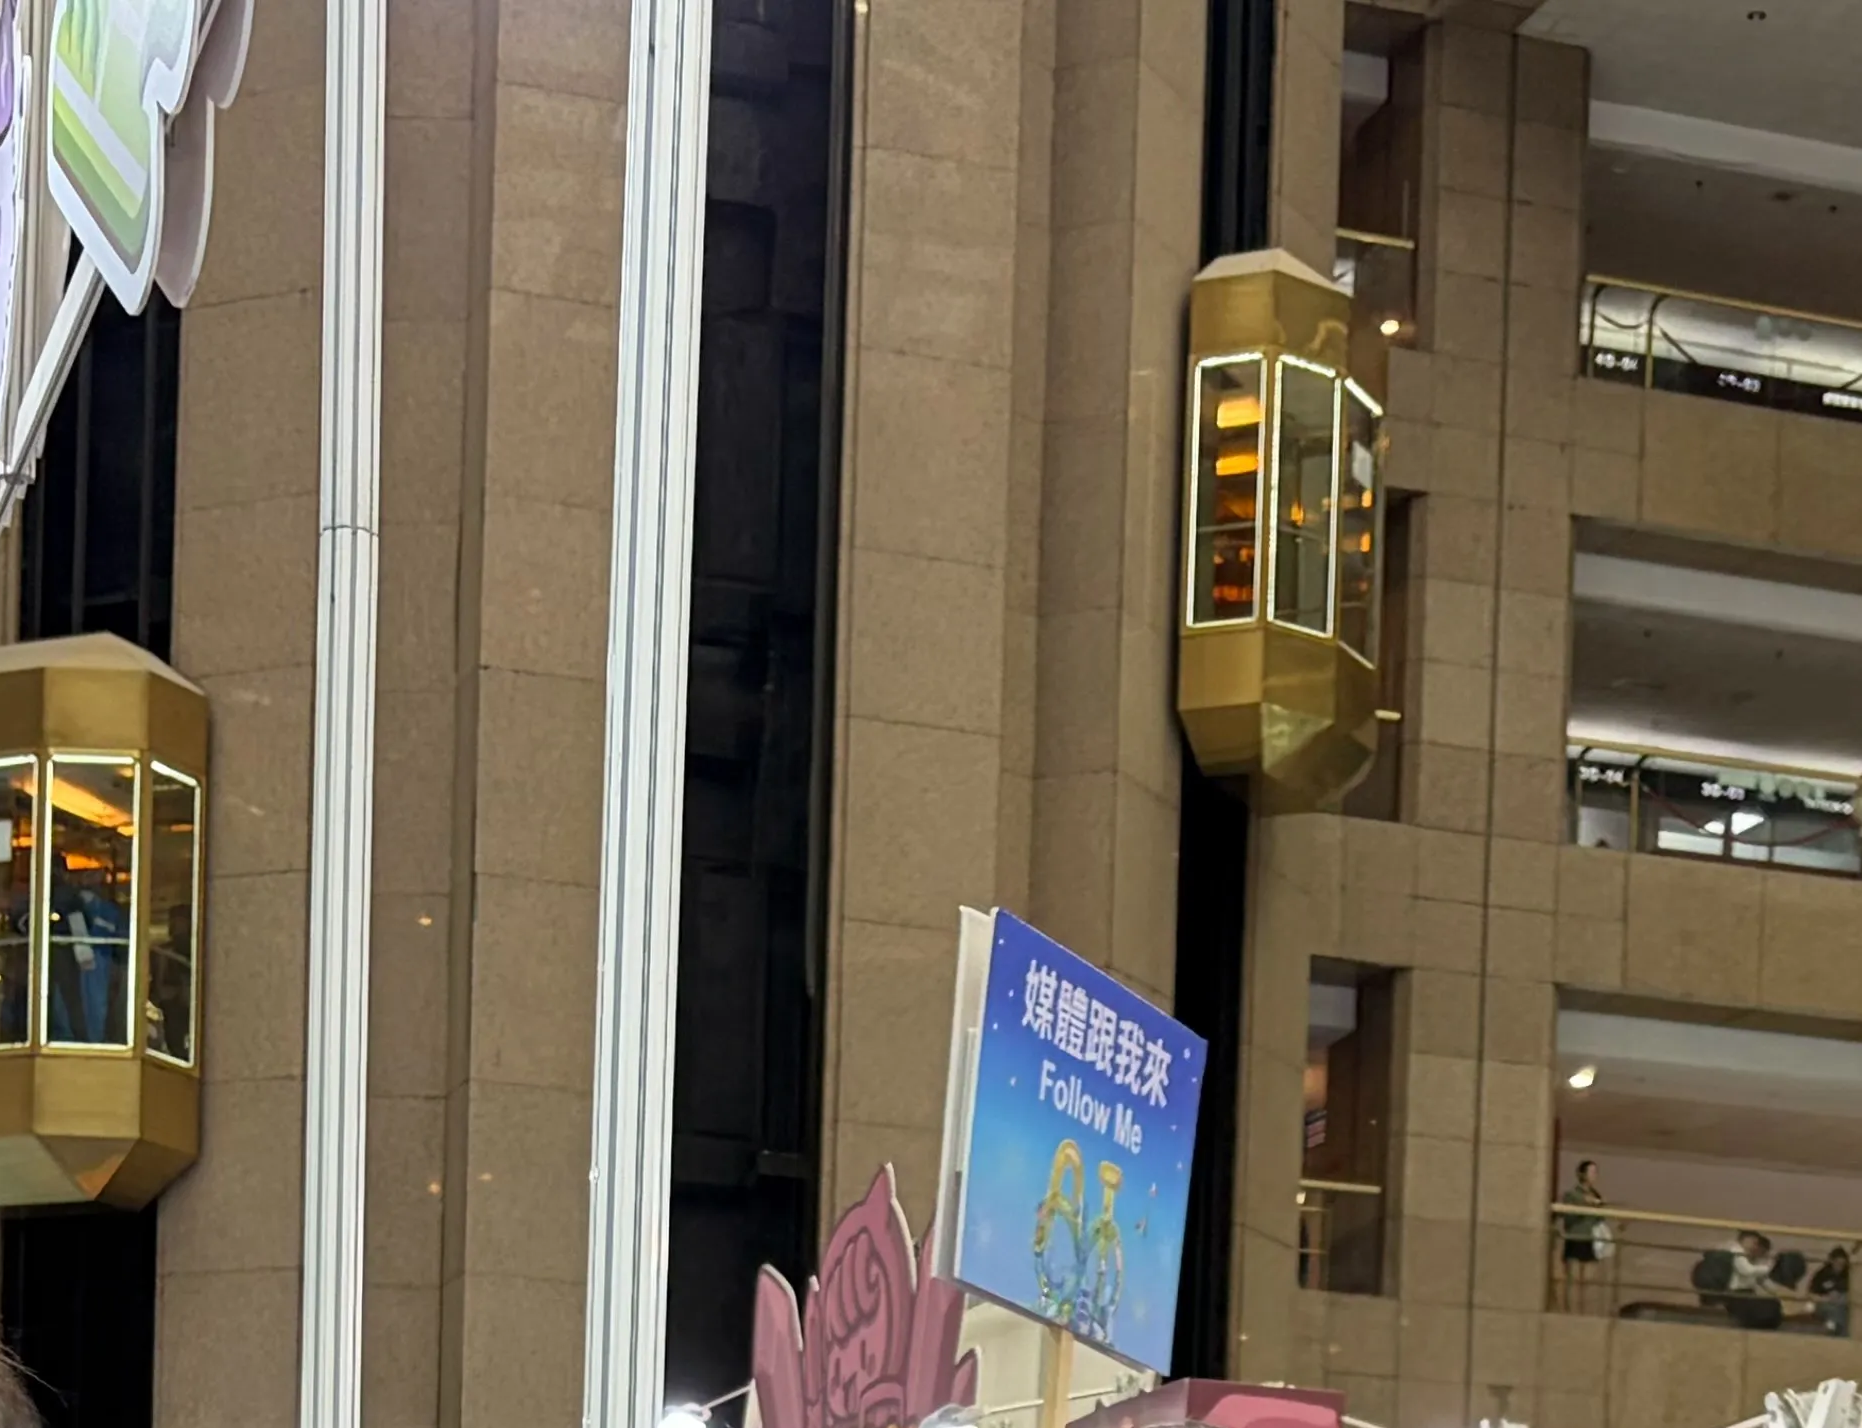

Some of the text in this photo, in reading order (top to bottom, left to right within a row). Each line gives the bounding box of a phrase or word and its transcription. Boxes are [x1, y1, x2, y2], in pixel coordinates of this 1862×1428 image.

[1022, 957, 1174, 1110] 媒體跟我來
[1039, 1060, 1144, 1156] Follow Me
